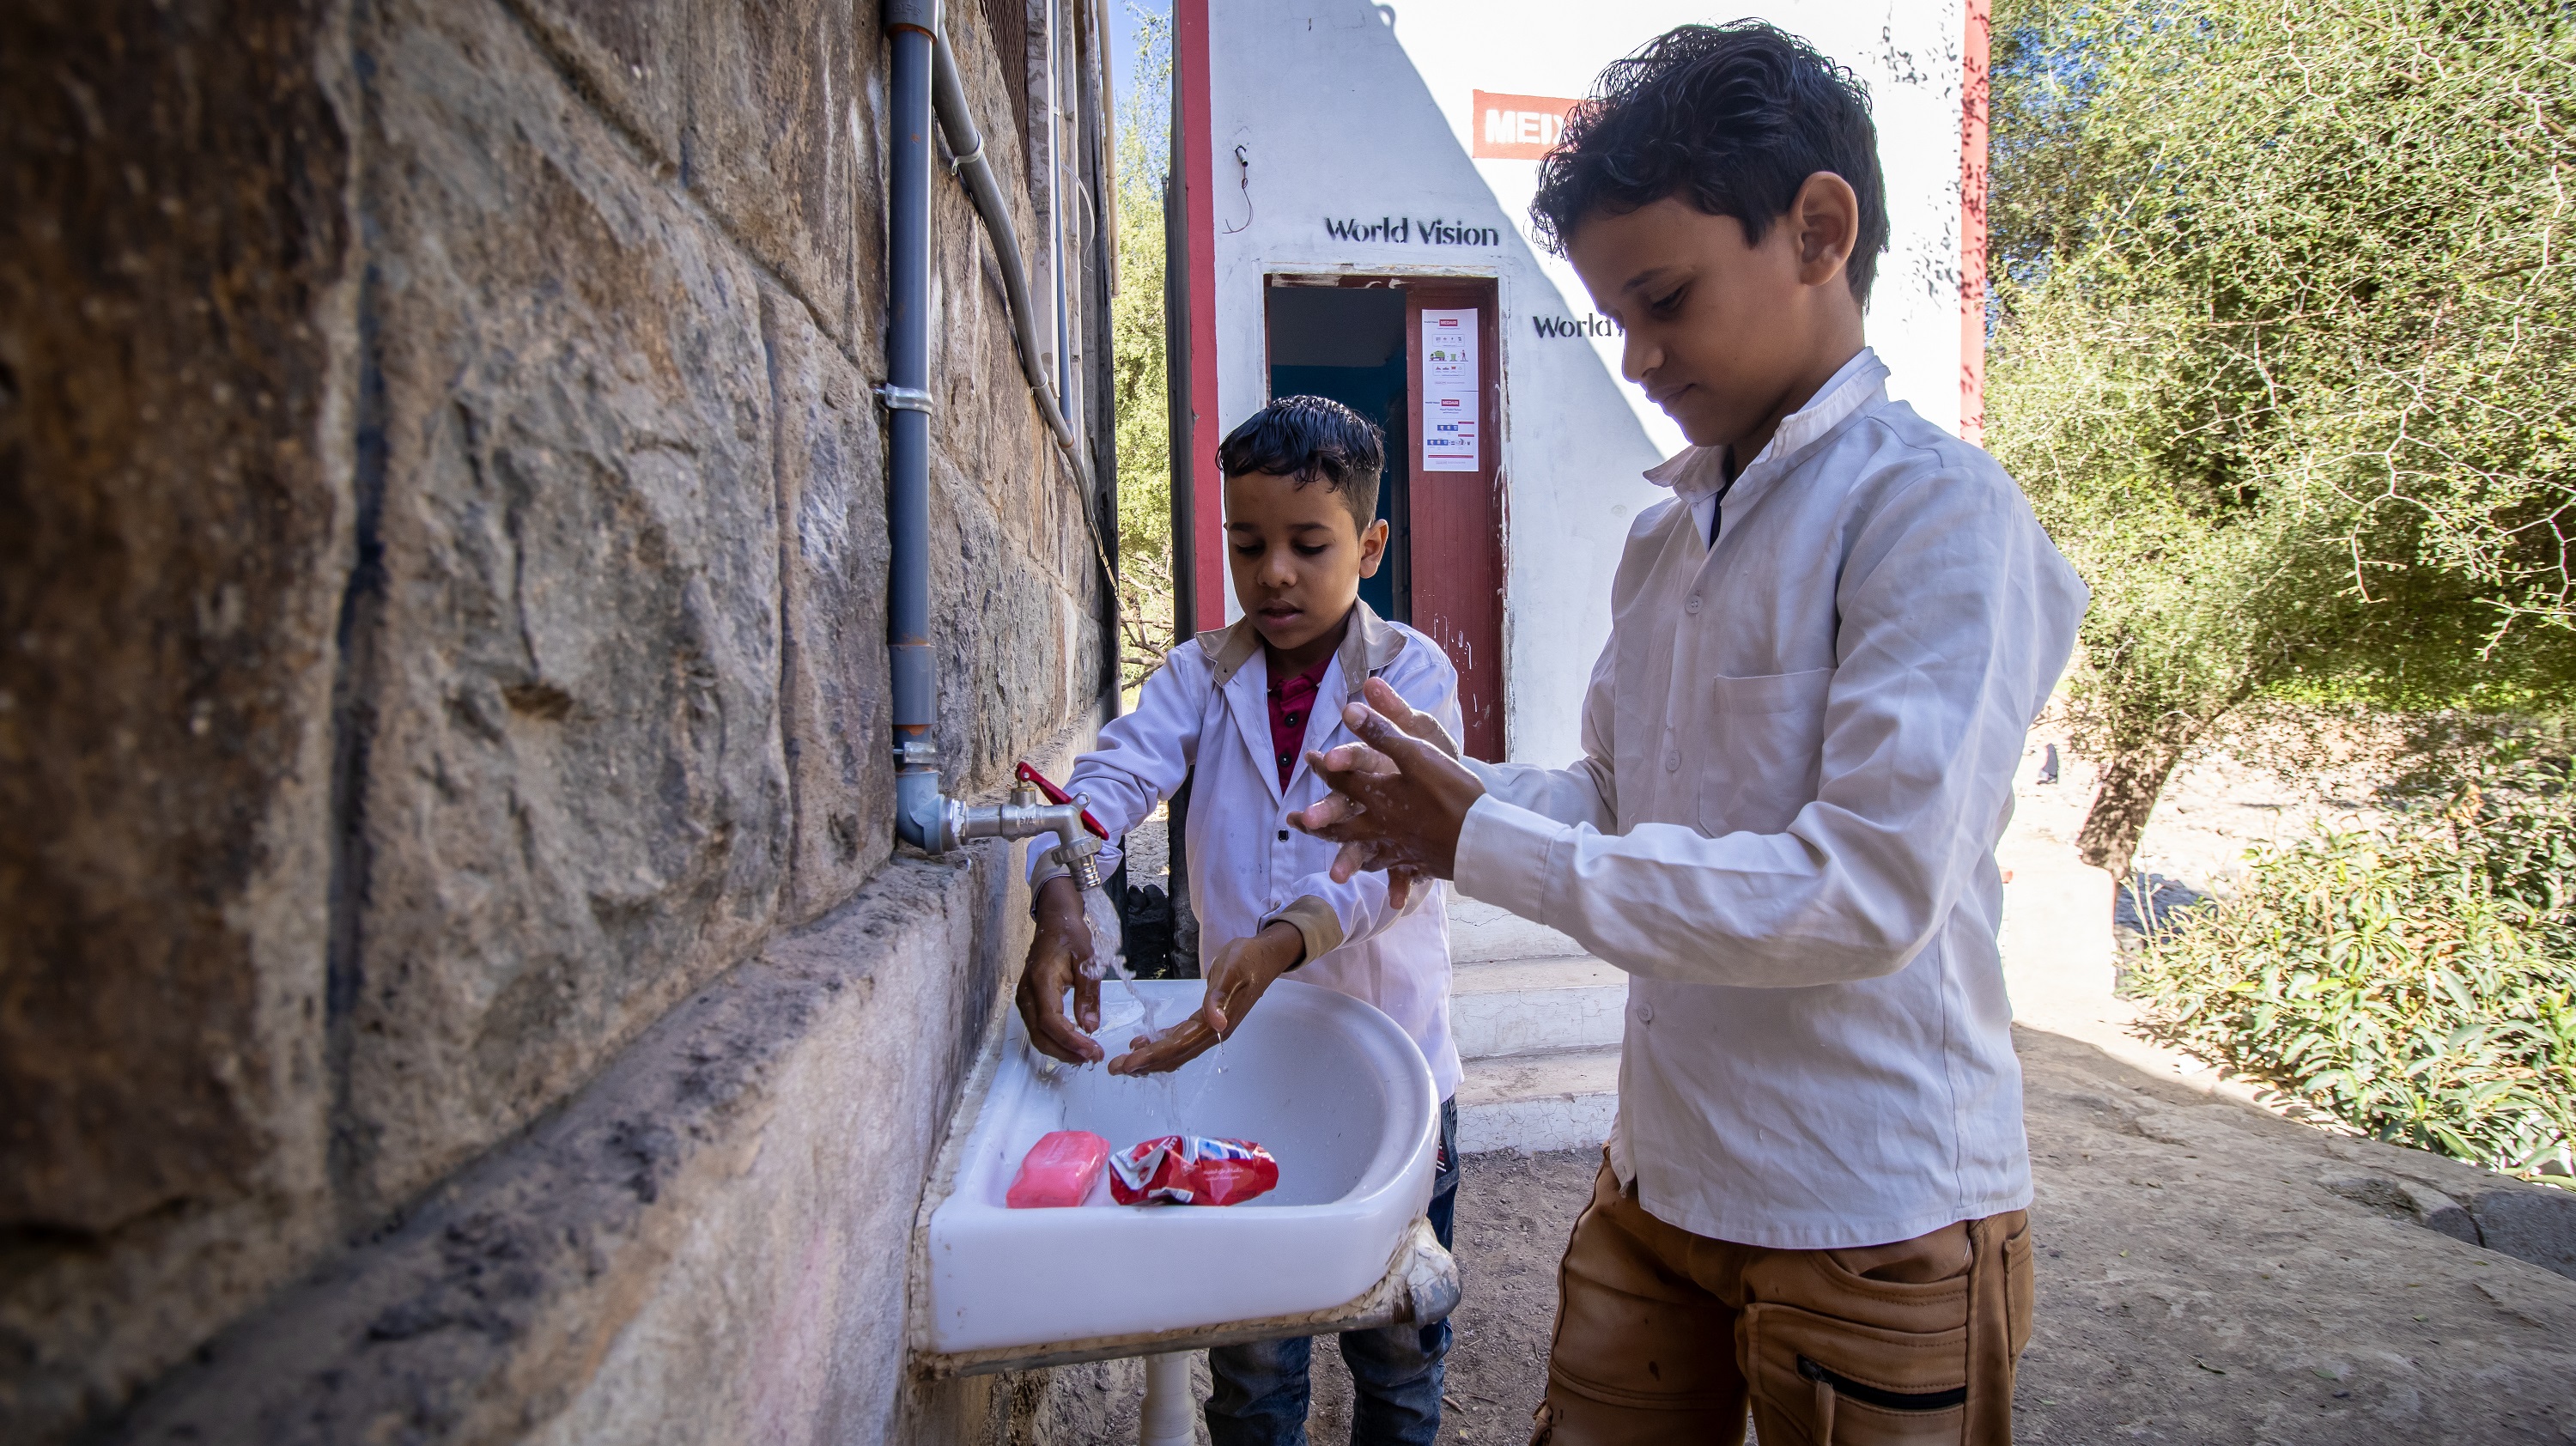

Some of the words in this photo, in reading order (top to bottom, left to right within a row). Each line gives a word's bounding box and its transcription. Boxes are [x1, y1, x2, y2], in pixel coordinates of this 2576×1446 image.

[1485, 108, 1566, 146] MED
[1324, 216, 1409, 244] World
[1417, 219, 1499, 246] Vision
[1532, 313, 1613, 339] World
